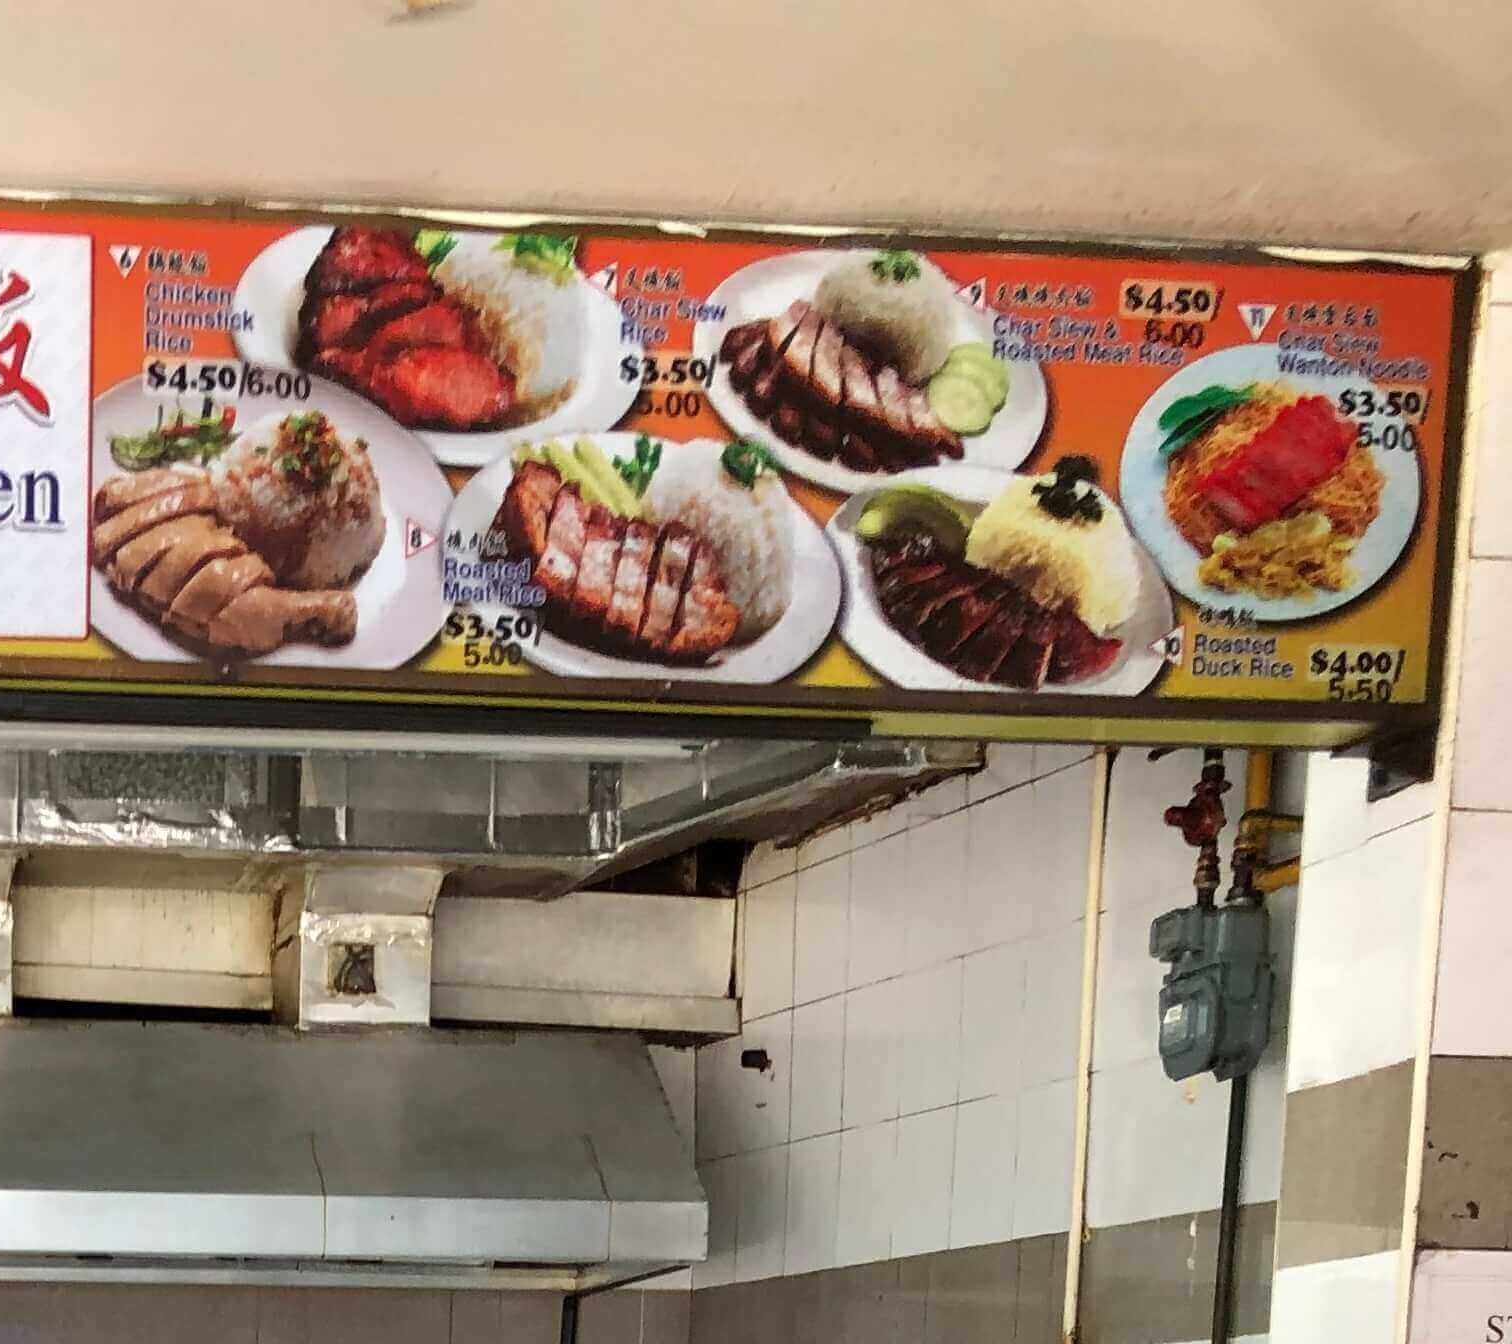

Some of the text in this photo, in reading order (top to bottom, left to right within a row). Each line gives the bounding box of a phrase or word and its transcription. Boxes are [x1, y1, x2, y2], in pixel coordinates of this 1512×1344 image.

[1194, 633, 1278, 656] Roasted
[1192, 656, 1295, 682] Duck Rice
